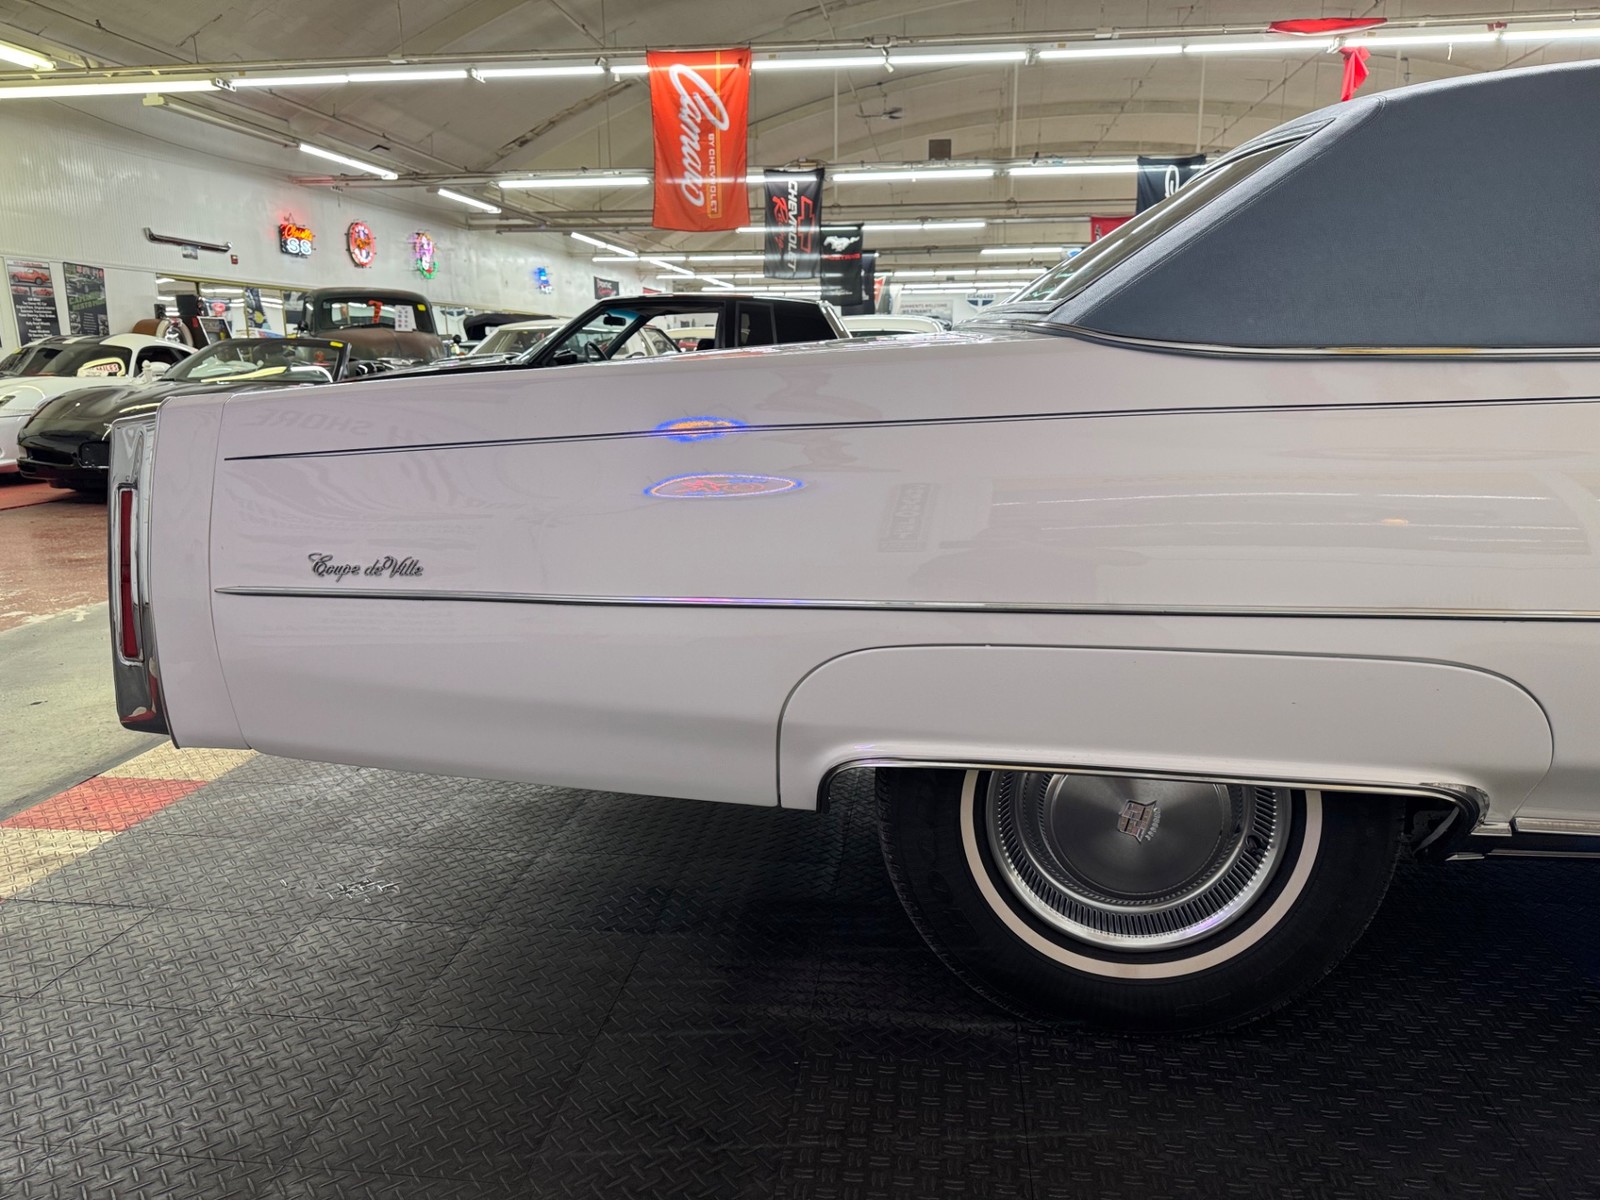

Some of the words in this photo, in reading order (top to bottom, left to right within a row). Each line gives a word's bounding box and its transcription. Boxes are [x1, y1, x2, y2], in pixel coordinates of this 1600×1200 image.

[668, 63, 730, 207] Camaro
[708, 132, 715, 147] BY
[708, 149, 718, 214] CHEVROLET
[286, 237, 312, 255] SS
[787, 179, 799, 273] CHEVROLET
[307, 552, 361, 583] Coupe
